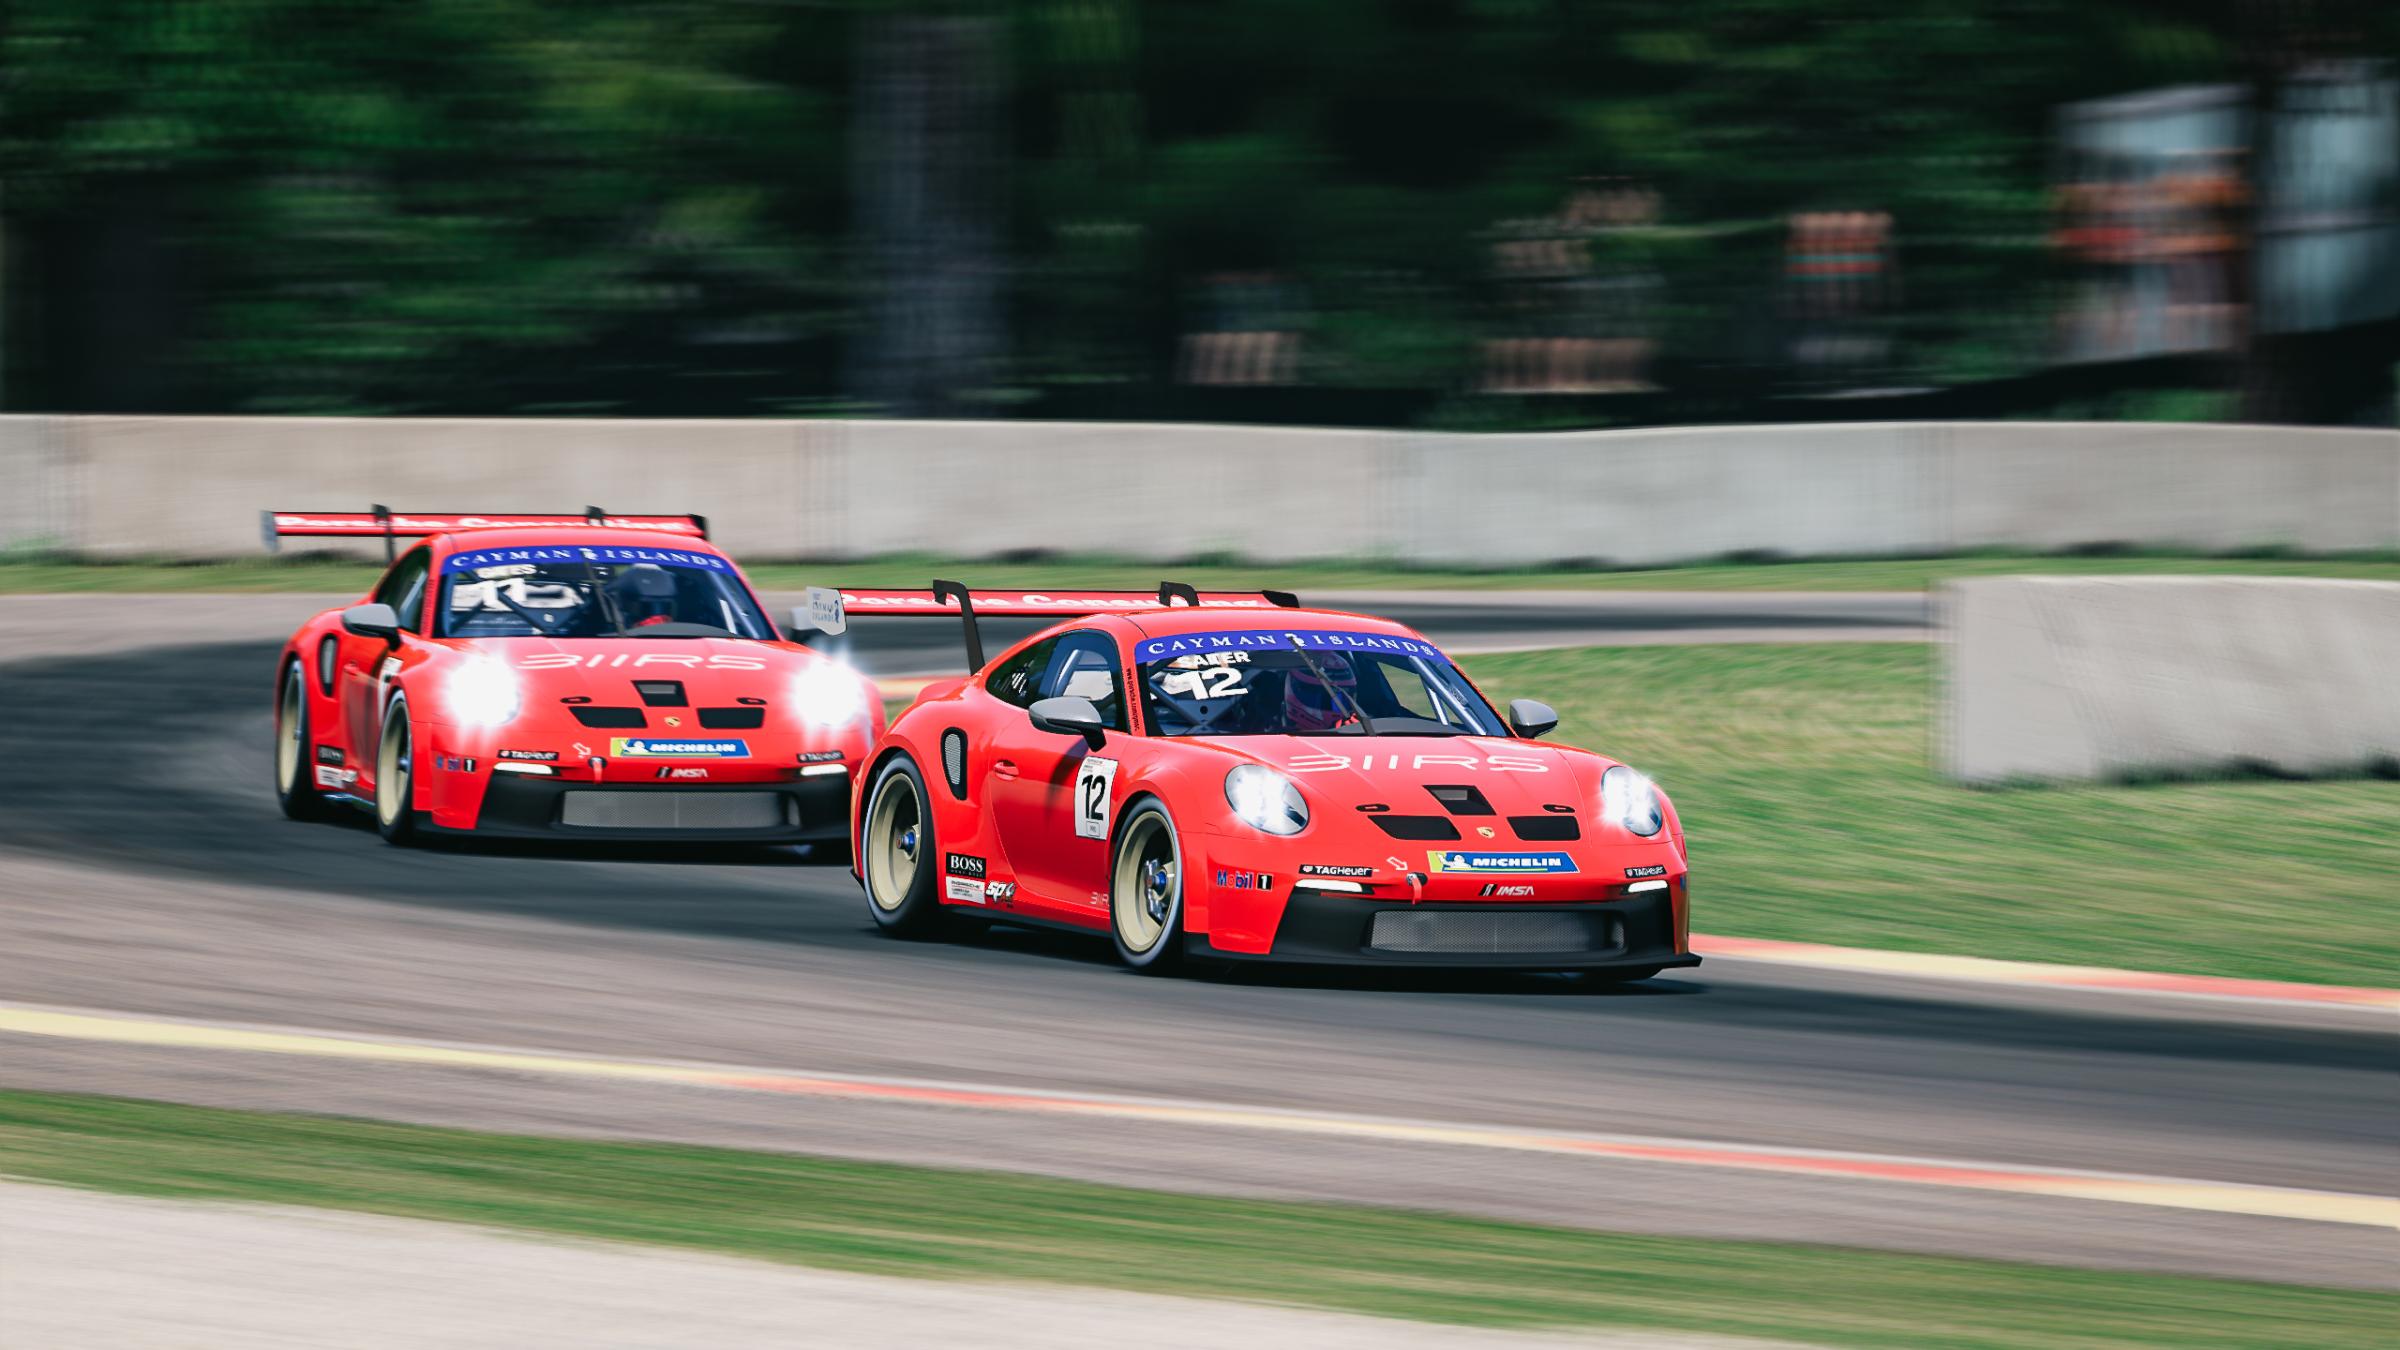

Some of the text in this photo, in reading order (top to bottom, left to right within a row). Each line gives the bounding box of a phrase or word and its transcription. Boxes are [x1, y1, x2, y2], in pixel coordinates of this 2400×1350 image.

[452, 550, 724, 569] CAYMAN ISLANDS
[1148, 635, 1435, 656] CAYMAN ISLANDS
[1183, 666, 1249, 700] 12
[650, 743, 737, 752] MICHELIN
[1082, 774, 1106, 821] 12
[950, 855, 983, 873] BOSS
[1472, 857, 1562, 867] MICHELIN
[1216, 869, 1254, 890] Mobil
[1496, 885, 1534, 896] IMSA
